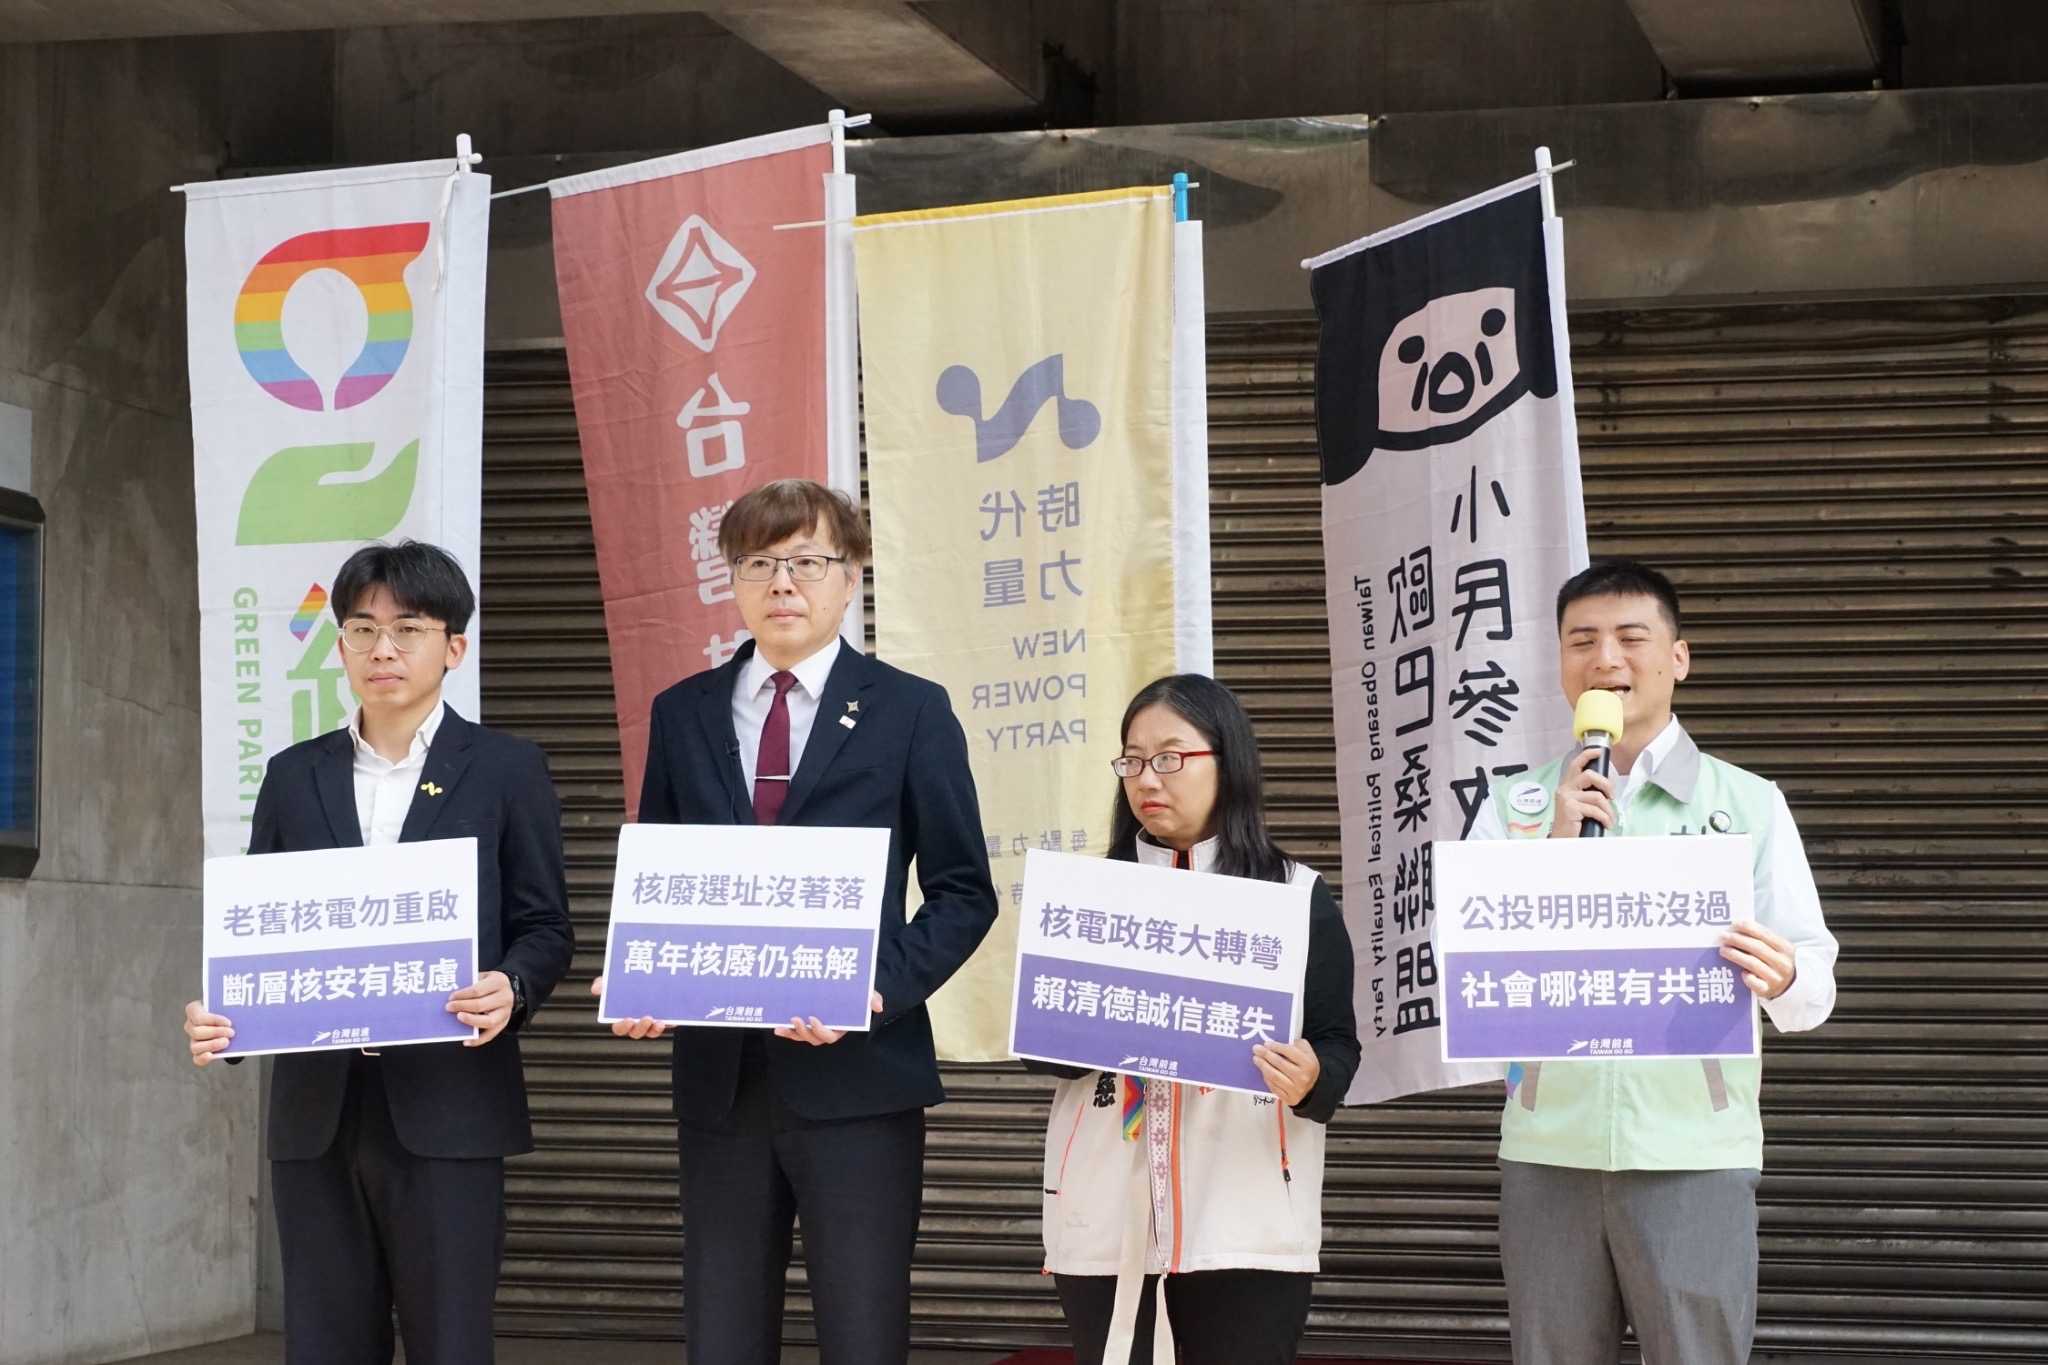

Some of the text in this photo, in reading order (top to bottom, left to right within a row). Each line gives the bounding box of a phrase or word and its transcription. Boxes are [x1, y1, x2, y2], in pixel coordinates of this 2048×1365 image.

[233, 587, 261, 703] GREEN
[632, 872, 865, 910] 核廢選址沒著落
[1459, 891, 1732, 932] 公投明明就沒過
[223, 889, 458, 937] 老舊核電勿重啟
[1039, 902, 1283, 971] 核電政策大轉彎
[623, 940, 859, 981] 萬年核廢仍無解
[222, 958, 459, 1007] 斷層核安有疑慮
[1461, 967, 1735, 1009] 社會哪裡有共識
[1032, 974, 1276, 1042] 賴清德誠信盡失
[1139, 1055, 1178, 1071] 台灣前進
[1589, 1038, 1633, 1049] 台灣前進
[1138, 1065, 1159, 1073] TAIWAN
